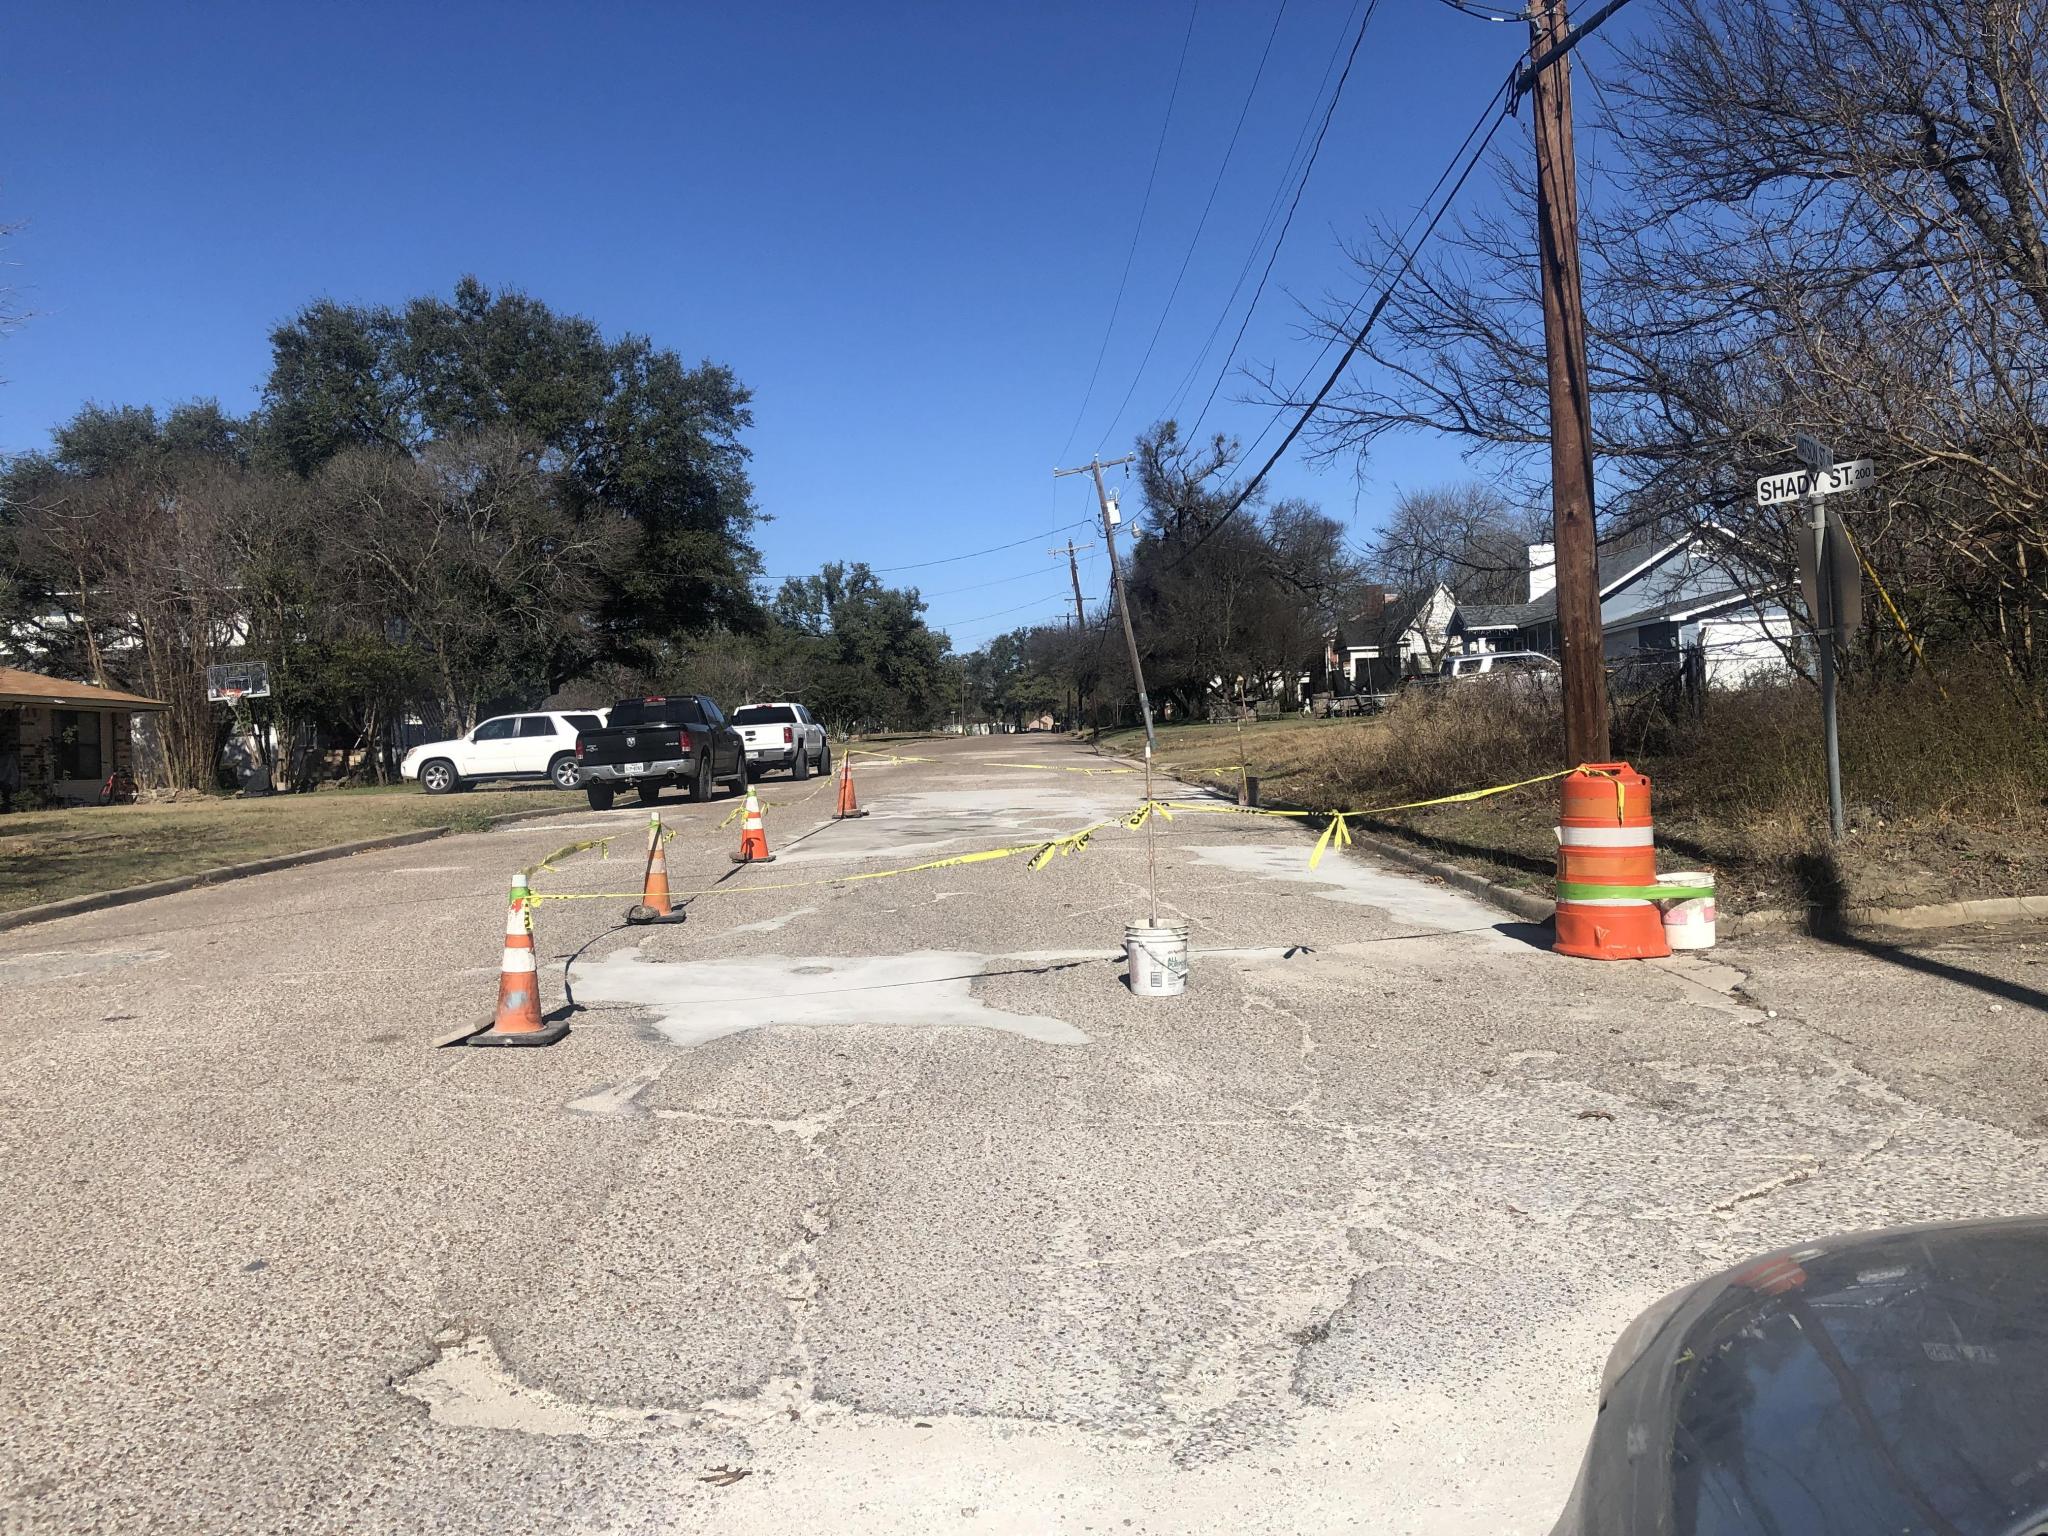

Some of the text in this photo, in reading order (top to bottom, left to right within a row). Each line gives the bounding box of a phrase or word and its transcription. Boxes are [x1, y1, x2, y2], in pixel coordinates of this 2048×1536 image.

[1760, 466, 1871, 502] SHADY ST. 200
